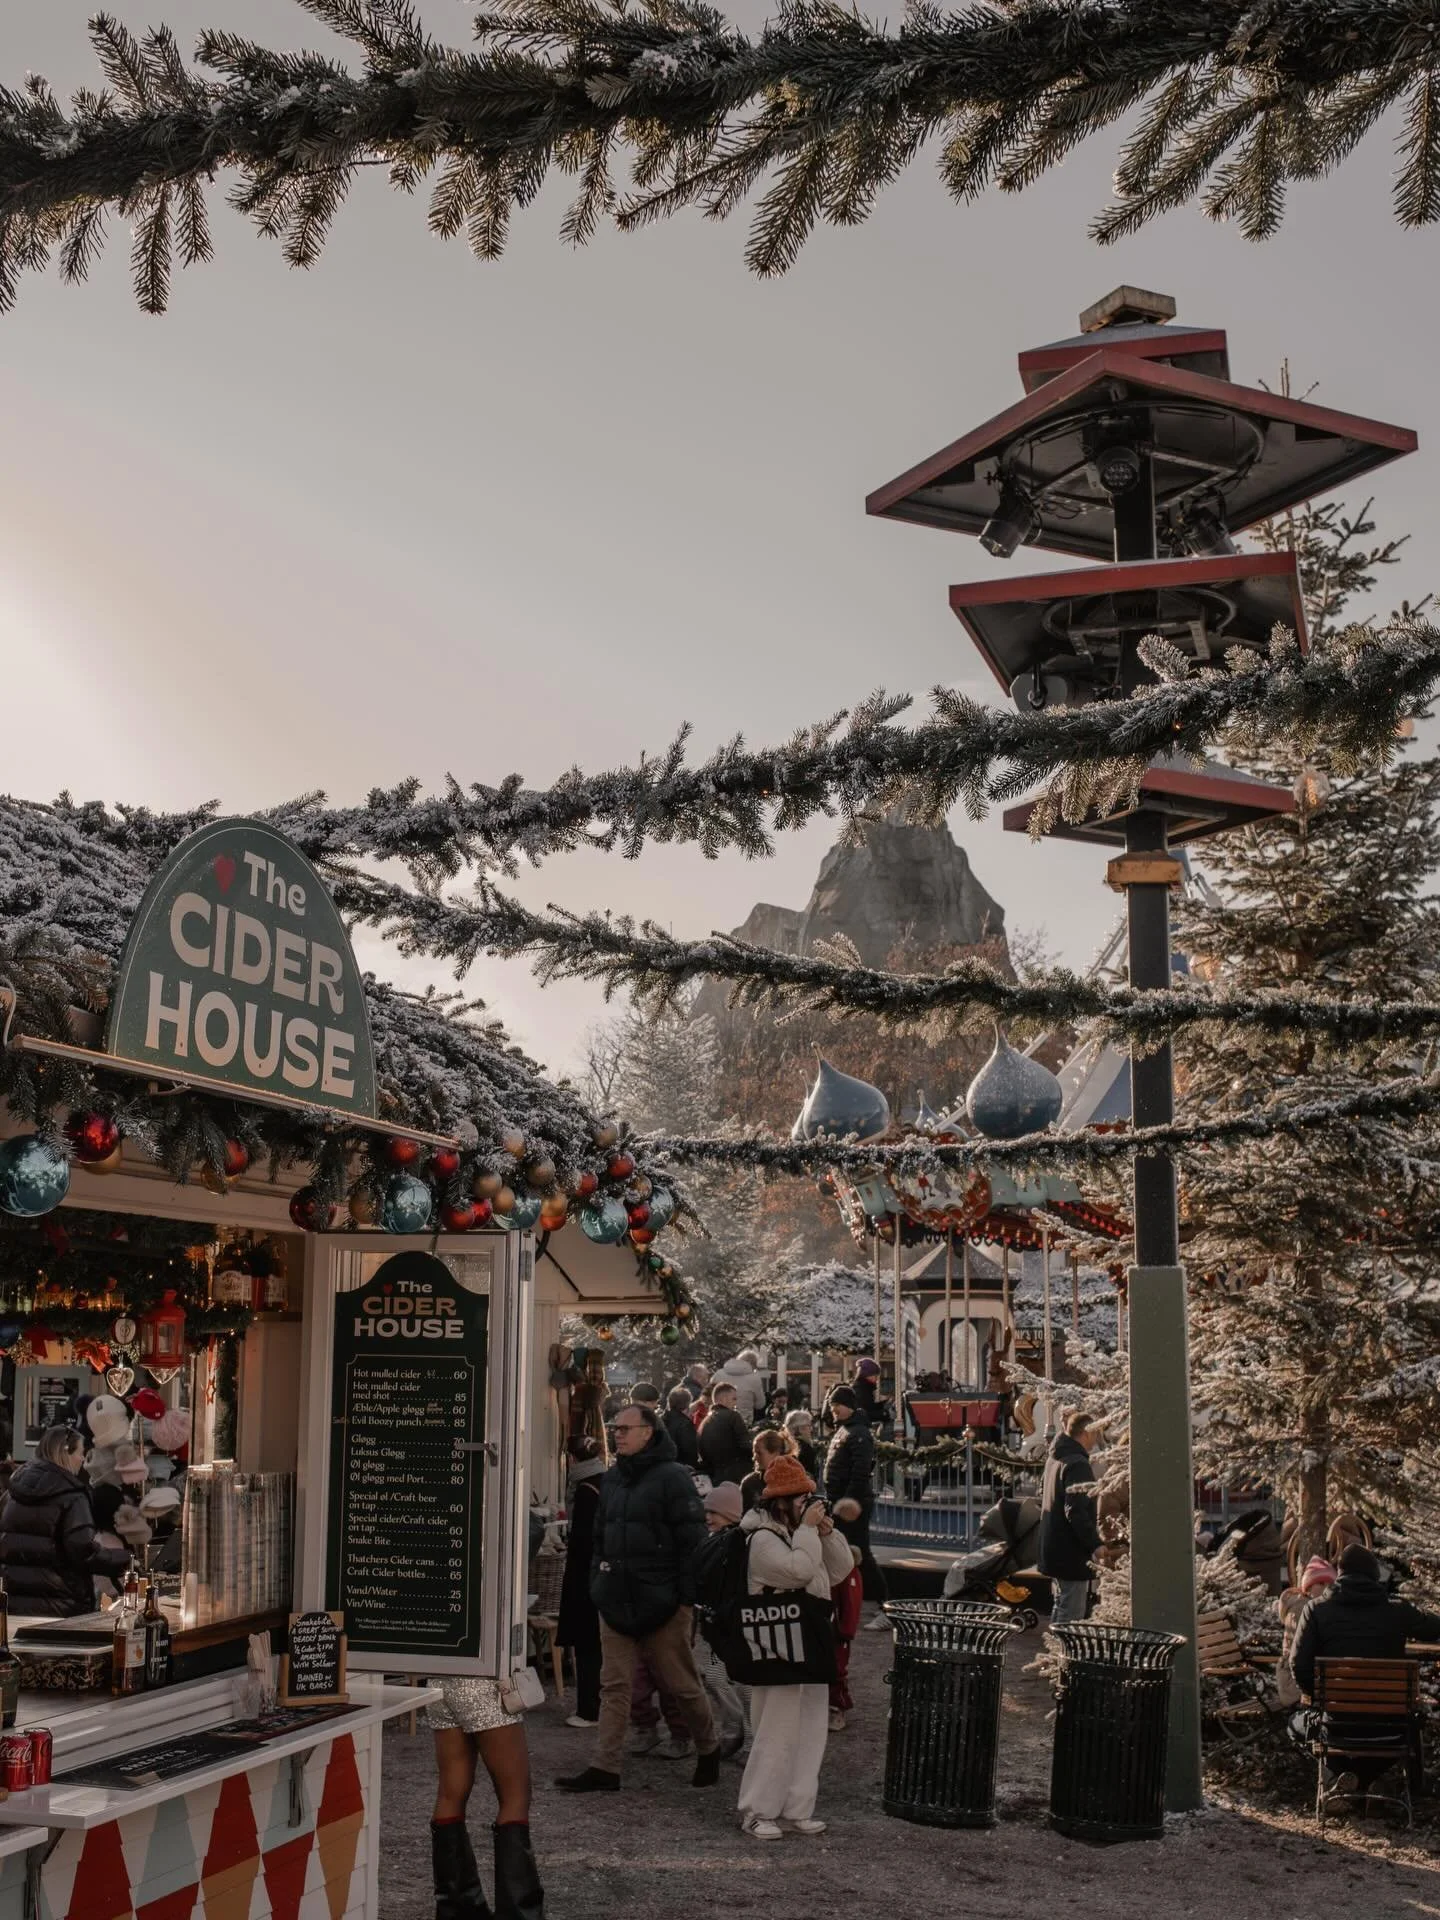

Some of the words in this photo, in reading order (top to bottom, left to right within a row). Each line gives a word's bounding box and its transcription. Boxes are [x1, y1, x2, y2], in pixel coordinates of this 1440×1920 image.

[243, 850, 306, 916] The
[169, 891, 344, 1015] CIDER
[144, 971, 356, 1098] HOUSE
[397, 1280, 433, 1293] The
[362, 1296, 457, 1316] CIDER
[354, 1318, 465, 1339] HOUSE
[353, 1368, 368, 1377] Hot
[371, 1368, 398, 1378] mulled
[400, 1369, 421, 1379] cider
[453, 1371, 467, 1380] 60
[352, 1381, 368, 1390] Hot
[371, 1382, 398, 1391] mulled
[400, 1382, 421, 1391] cider
[352, 1391, 371, 1400] med
[373, 1391, 390, 1400] shot
[454, 1393, 467, 1402] 85
[402, 1404, 425, 1416] gløgg
[452, 1406, 466, 1415] 60
[352, 1416, 366, 1425] Evil
[368, 1416, 393, 1427] Boozy
[395, 1418, 421, 1428] punch
[453, 1419, 466, 1428] 85
[351, 1434, 376, 1446] Gløgg
[351, 1447, 378, 1456] Luksus
[380, 1448, 405, 1460] Gløgg
[451, 1450, 465, 1459] 90
[362, 1460, 385, 1471] gløgg
[450, 1463, 464, 1472] 60
[362, 1473, 385, 1484] gløgg
[386, 1474, 405, 1483] med
[406, 1474, 424, 1483] Port
[450, 1476, 464, 1485] 80
[349, 1491, 378, 1502] Special
[418, 1493, 437, 1503] beer
[362, 1502, 376, 1512] tap
[449, 1504, 463, 1513] 60
[348, 1513, 378, 1524] Special
[380, 1514, 425, 1525] cider/Craft
[427, 1515, 449, 1526] cider
[361, 1524, 375, 1534] tap
[449, 1526, 463, 1536] 60
[347, 1535, 372, 1545] Snake
[374, 1536, 391, 1546] Bite
[450, 1540, 463, 1549] 70
[347, 1553, 389, 1565] Thatchers
[390, 1555, 413, 1566] Cider
[415, 1558, 435, 1567] cans
[448, 1558, 462, 1567] 60
[346, 1566, 369, 1577] Craft
[371, 1567, 395, 1577] Cider
[397, 1568, 426, 1579] bottles
[449, 1571, 462, 1580] 65
[346, 1585, 398, 1597] Vand/Water
[450, 1590, 462, 1600] 25
[346, 1598, 386, 1610] Vin/Wine
[449, 1603, 462, 1613] 70
[741, 1604, 801, 1623] RADIO
[298, 1626, 320, 1634] GREAT
[297, 1673, 324, 1683] BANNED
[309, 1682, 327, 1690] BARS
